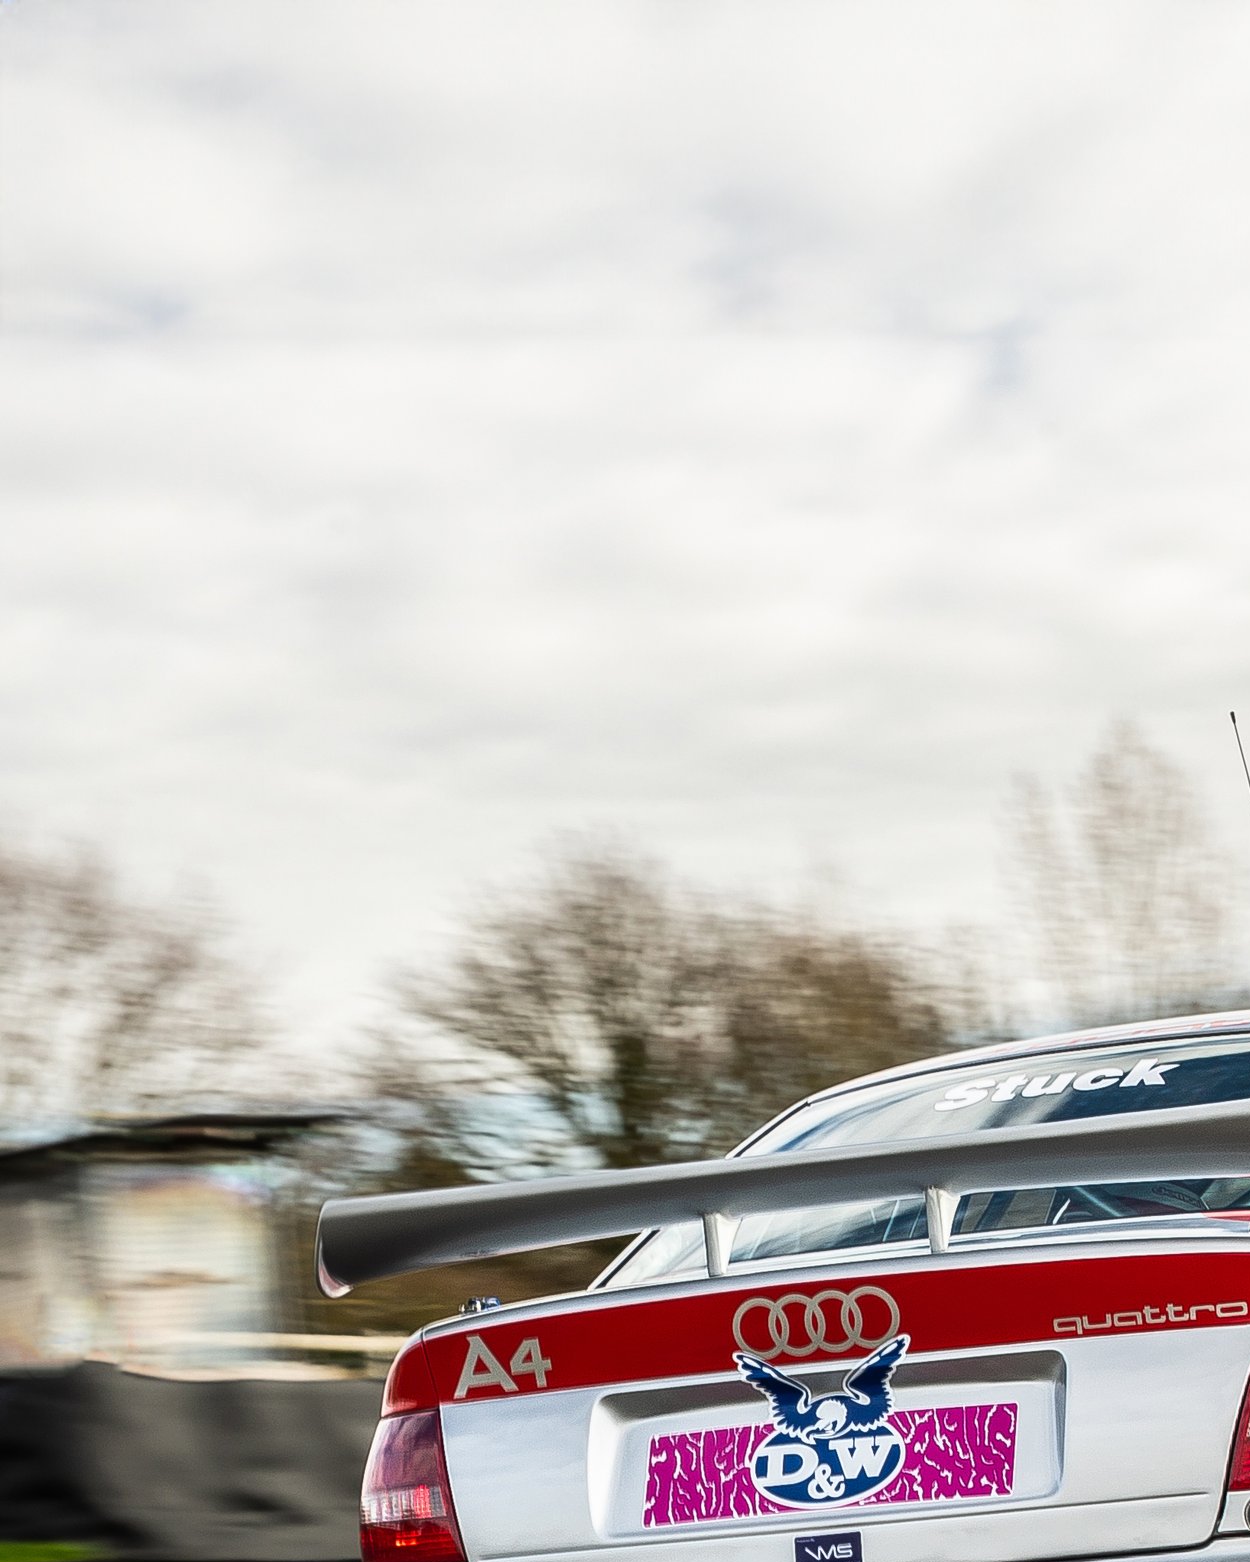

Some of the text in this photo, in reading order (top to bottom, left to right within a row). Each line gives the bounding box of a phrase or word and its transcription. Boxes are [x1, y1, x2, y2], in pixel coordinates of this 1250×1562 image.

[934, 1058, 1181, 1112] Stuck
[1052, 1300, 1248, 1335] quattro
[454, 1334, 552, 1398] A4
[760, 1434, 900, 1500] D&W
